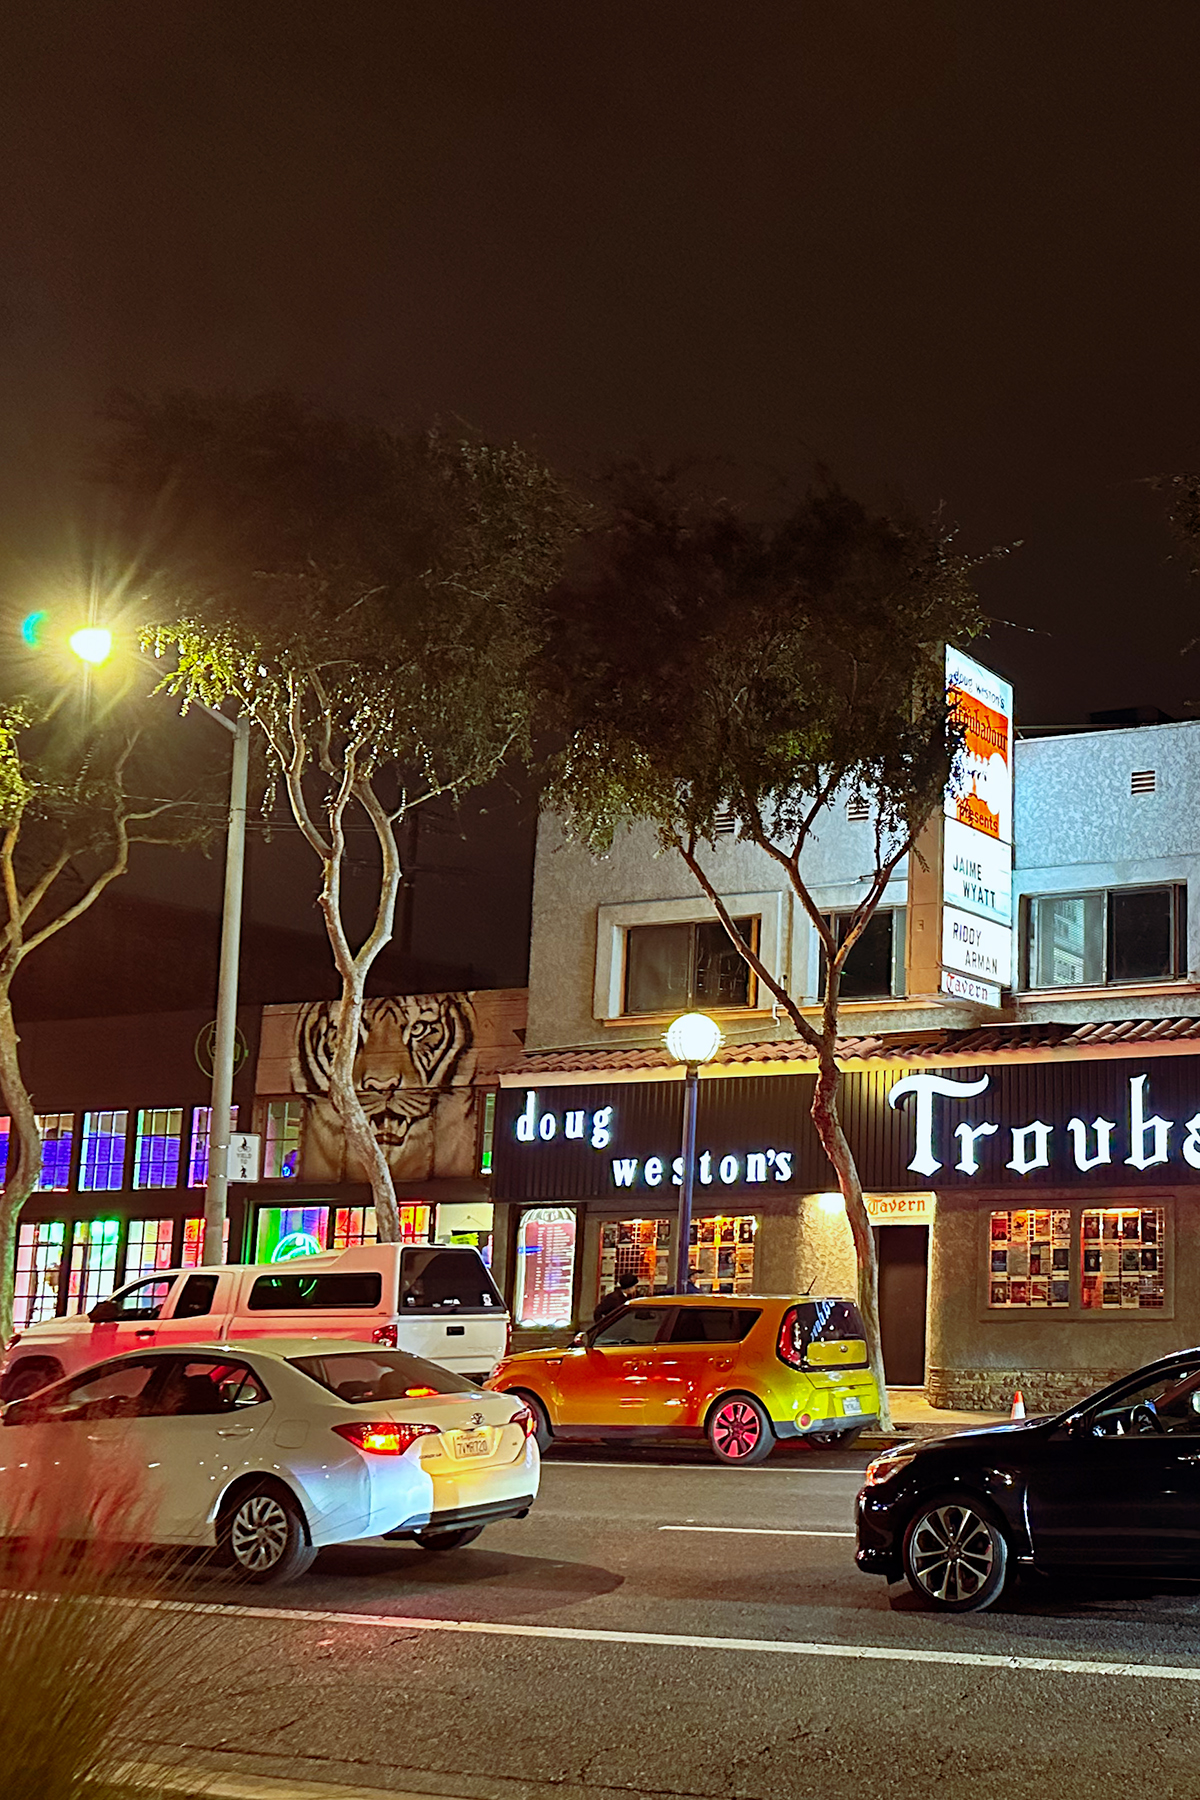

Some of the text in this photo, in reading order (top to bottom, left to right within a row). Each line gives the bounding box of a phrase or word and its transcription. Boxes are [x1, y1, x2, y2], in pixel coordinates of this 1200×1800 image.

[953, 855, 983, 881] JAIME
[963, 880, 996, 908] WYATT
[952, 922, 982, 947] RIDDY
[965, 950, 998, 975] ARMAN
[946, 973, 988, 1000] Tavern
[516, 1090, 613, 1149] doug
[612, 1149, 792, 1187] weston's
[868, 1198, 925, 1215] Tavern
